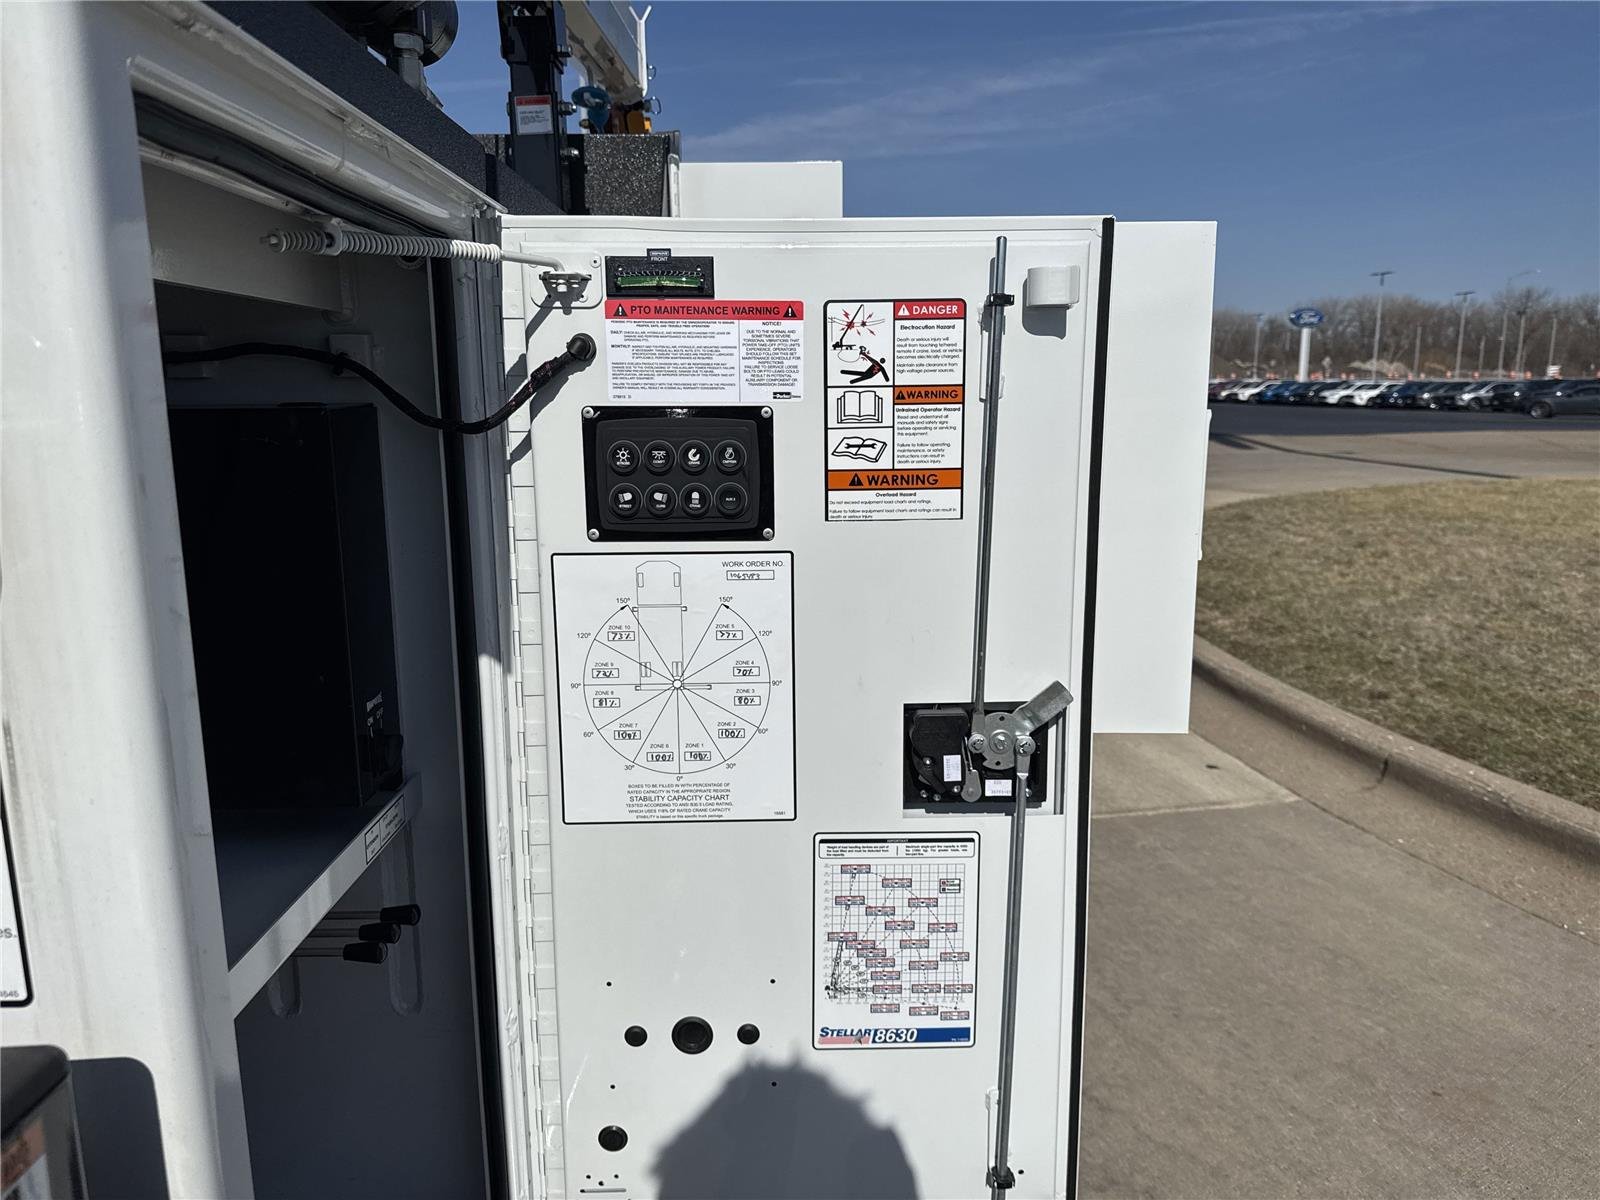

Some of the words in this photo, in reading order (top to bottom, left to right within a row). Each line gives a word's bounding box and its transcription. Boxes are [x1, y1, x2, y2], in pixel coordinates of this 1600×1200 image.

[630, 305, 651, 315] PTO
[654, 305, 728, 315] MAINTENANCE
[731, 306, 780, 315] WARNING
[913, 305, 958, 315] DANGER
[906, 389, 959, 399] WARNING
[867, 474, 939, 486] WARNING
[611, 632, 632, 640] 73%
[736, 668, 754, 676] 70%
[737, 696, 756, 705] 80%
[617, 731, 637, 739] 100%
[721, 729, 743, 738] 100%
[650, 754, 674, 762] 100%
[689, 752, 709, 760] 100%
[819, 1026, 872, 1038] STELLAR
[874, 1028, 918, 1043] 8630
